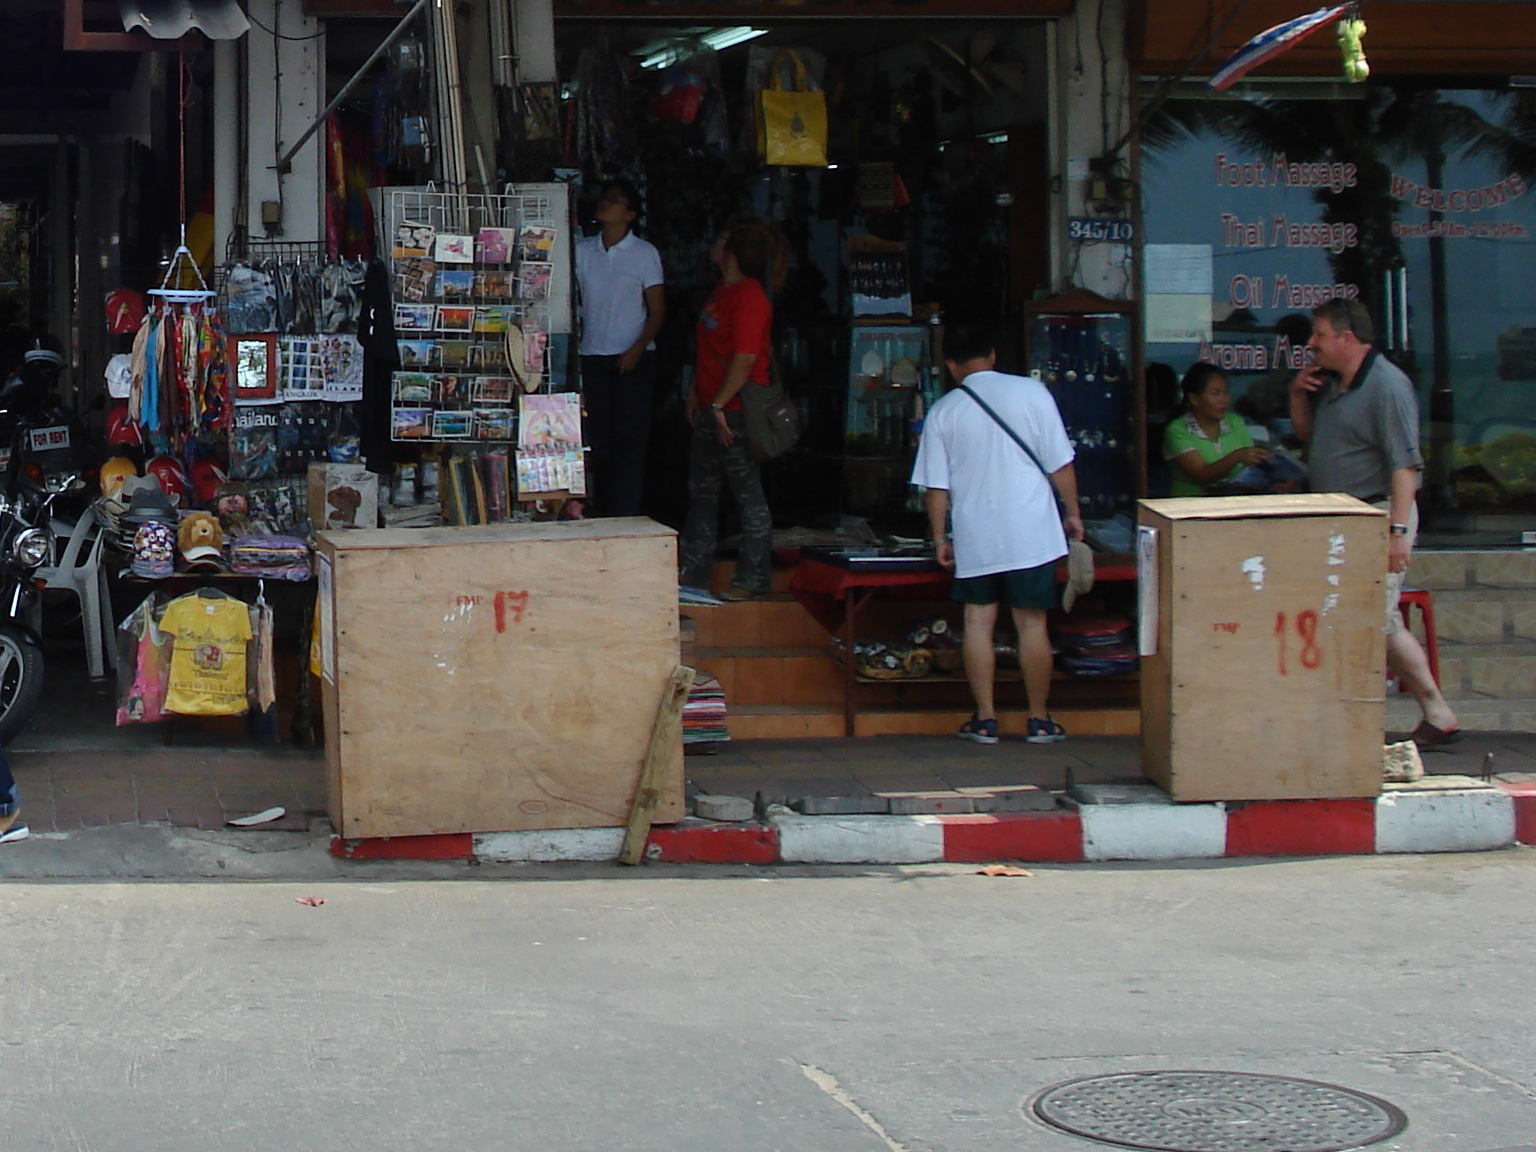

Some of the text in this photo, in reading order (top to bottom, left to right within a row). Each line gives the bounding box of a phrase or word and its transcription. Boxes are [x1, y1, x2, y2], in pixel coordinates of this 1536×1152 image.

[1215, 152, 1358, 193] Foot Massage
[1389, 172, 1529, 212] WELCOME
[1069, 220, 1133, 240] 345/10
[1221, 213, 1358, 253] Thai Massage
[1229, 274, 1263, 308] Oil
[1199, 339, 1268, 369] Aroma
[33, 431, 68, 446] FOR RENT
[493, 589, 529, 634] 17
[1274, 609, 1322, 676] 18
